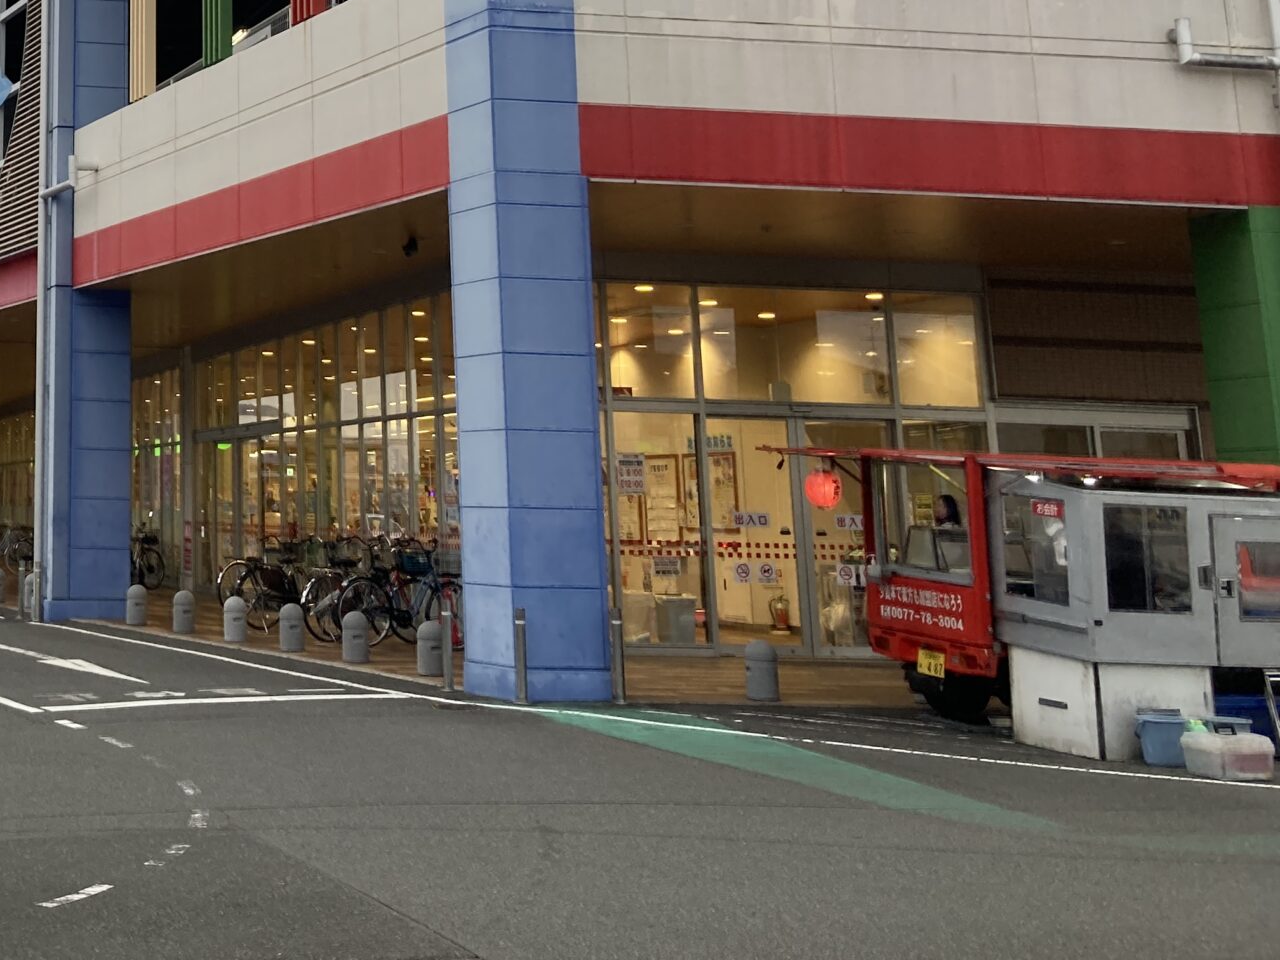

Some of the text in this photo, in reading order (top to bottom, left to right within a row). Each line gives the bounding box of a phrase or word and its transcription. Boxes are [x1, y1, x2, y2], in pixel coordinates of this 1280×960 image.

[734, 514, 768, 526] 出入口
[836, 517, 865, 528] 出入
